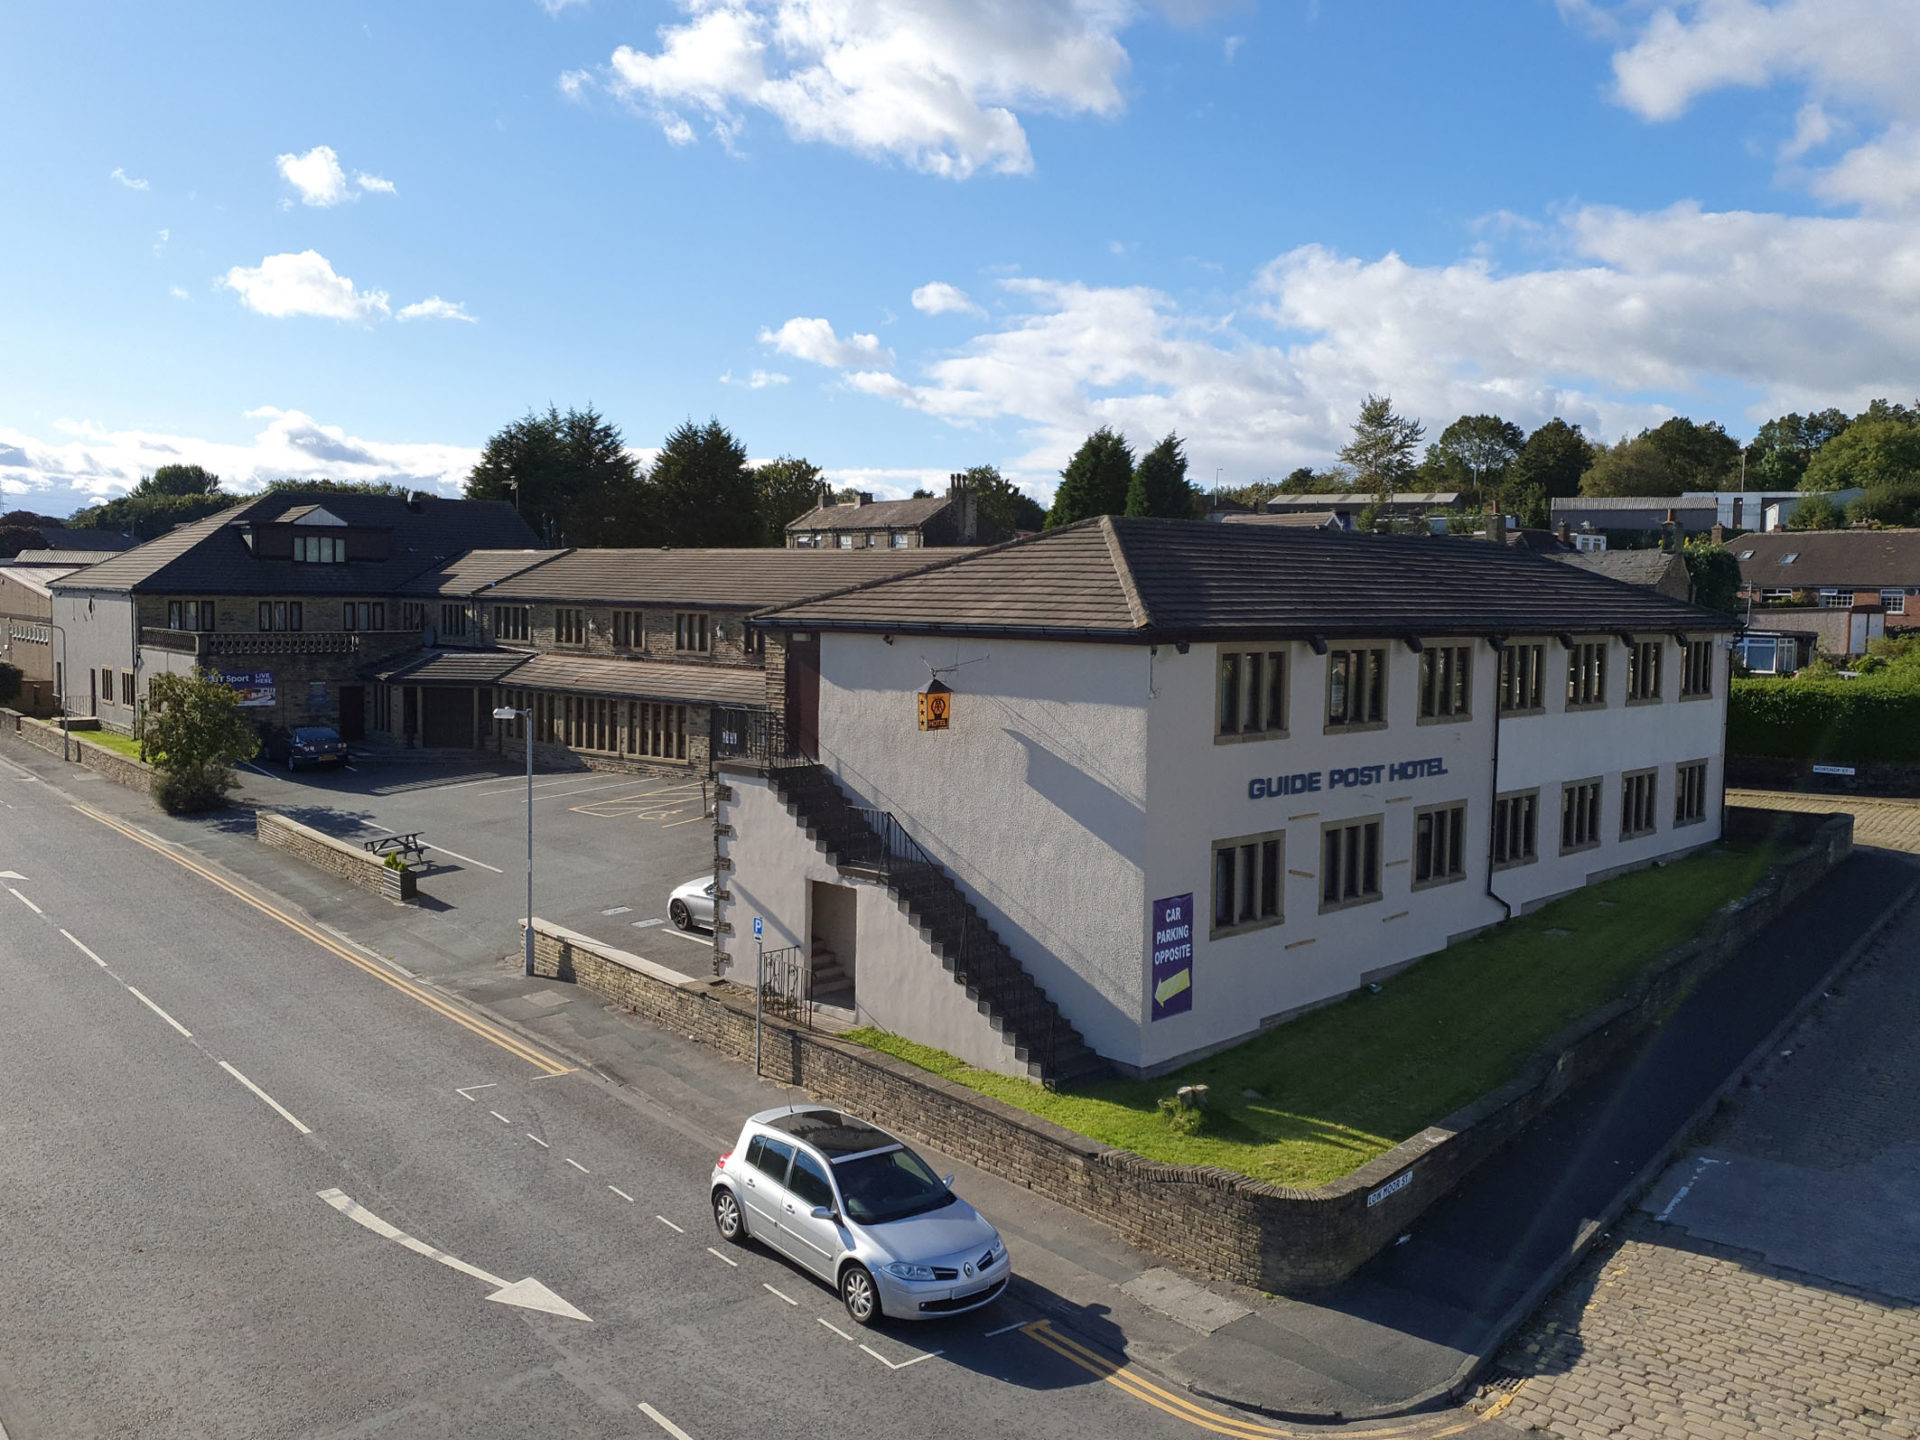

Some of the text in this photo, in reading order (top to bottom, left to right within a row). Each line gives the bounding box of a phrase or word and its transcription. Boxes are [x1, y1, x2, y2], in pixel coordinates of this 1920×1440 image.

[226, 675, 250, 683] Sport
[928, 720, 947, 728] HOTEL
[1248, 757, 1448, 799] GUIDE POST HOTEL
[1166, 907, 1180, 922] CAR
[755, 919, 762, 933] P
[1157, 925, 1189, 944] PARKING
[1155, 944, 1191, 965] OPPOSITE
[1369, 1174, 1409, 1205] LOW MOOR ST
